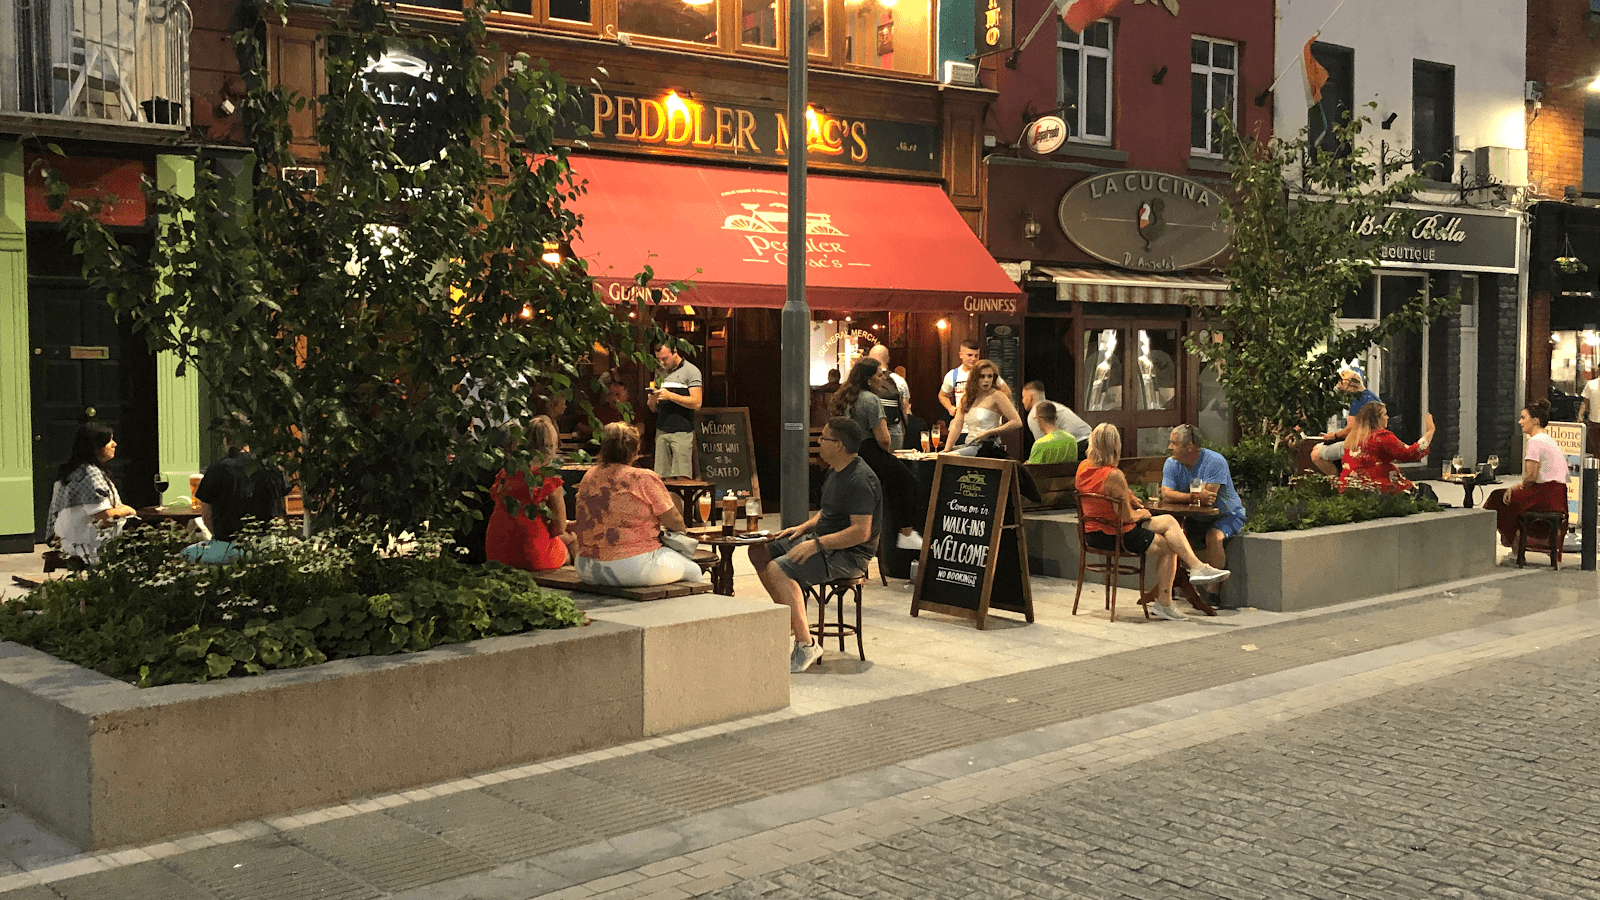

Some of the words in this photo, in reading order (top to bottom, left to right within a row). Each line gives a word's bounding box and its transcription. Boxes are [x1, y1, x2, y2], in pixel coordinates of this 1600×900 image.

[591, 93, 761, 154] PEDDLER
[1090, 178, 1119, 199] LA
[1124, 174, 1210, 207] CUCINA
[1411, 214, 1467, 242] Bella
[1381, 246, 1436, 261] BOUTIQUE
[608, 282, 678, 303] GUINNSS
[963, 295, 1015, 312] GUINNESS
[819, 330, 850, 357] GENERAL
[701, 420, 736, 435] WELCOME
[1544, 427, 1581, 440] thlone
[702, 442, 723, 453] PLEASE
[725, 442, 740, 453] WAIT
[1556, 440, 1581, 448] TOURS
[706, 465, 740, 478] SEATED
[947, 499, 968, 513] Come
[968, 505, 980, 515] on
[980, 503, 990, 516] in
[942, 515, 986, 538] WALK-INS
[930, 535, 990, 568] WELCOME
[937, 570, 947, 578] NO
[946, 571, 977, 585] BOOKINGS
